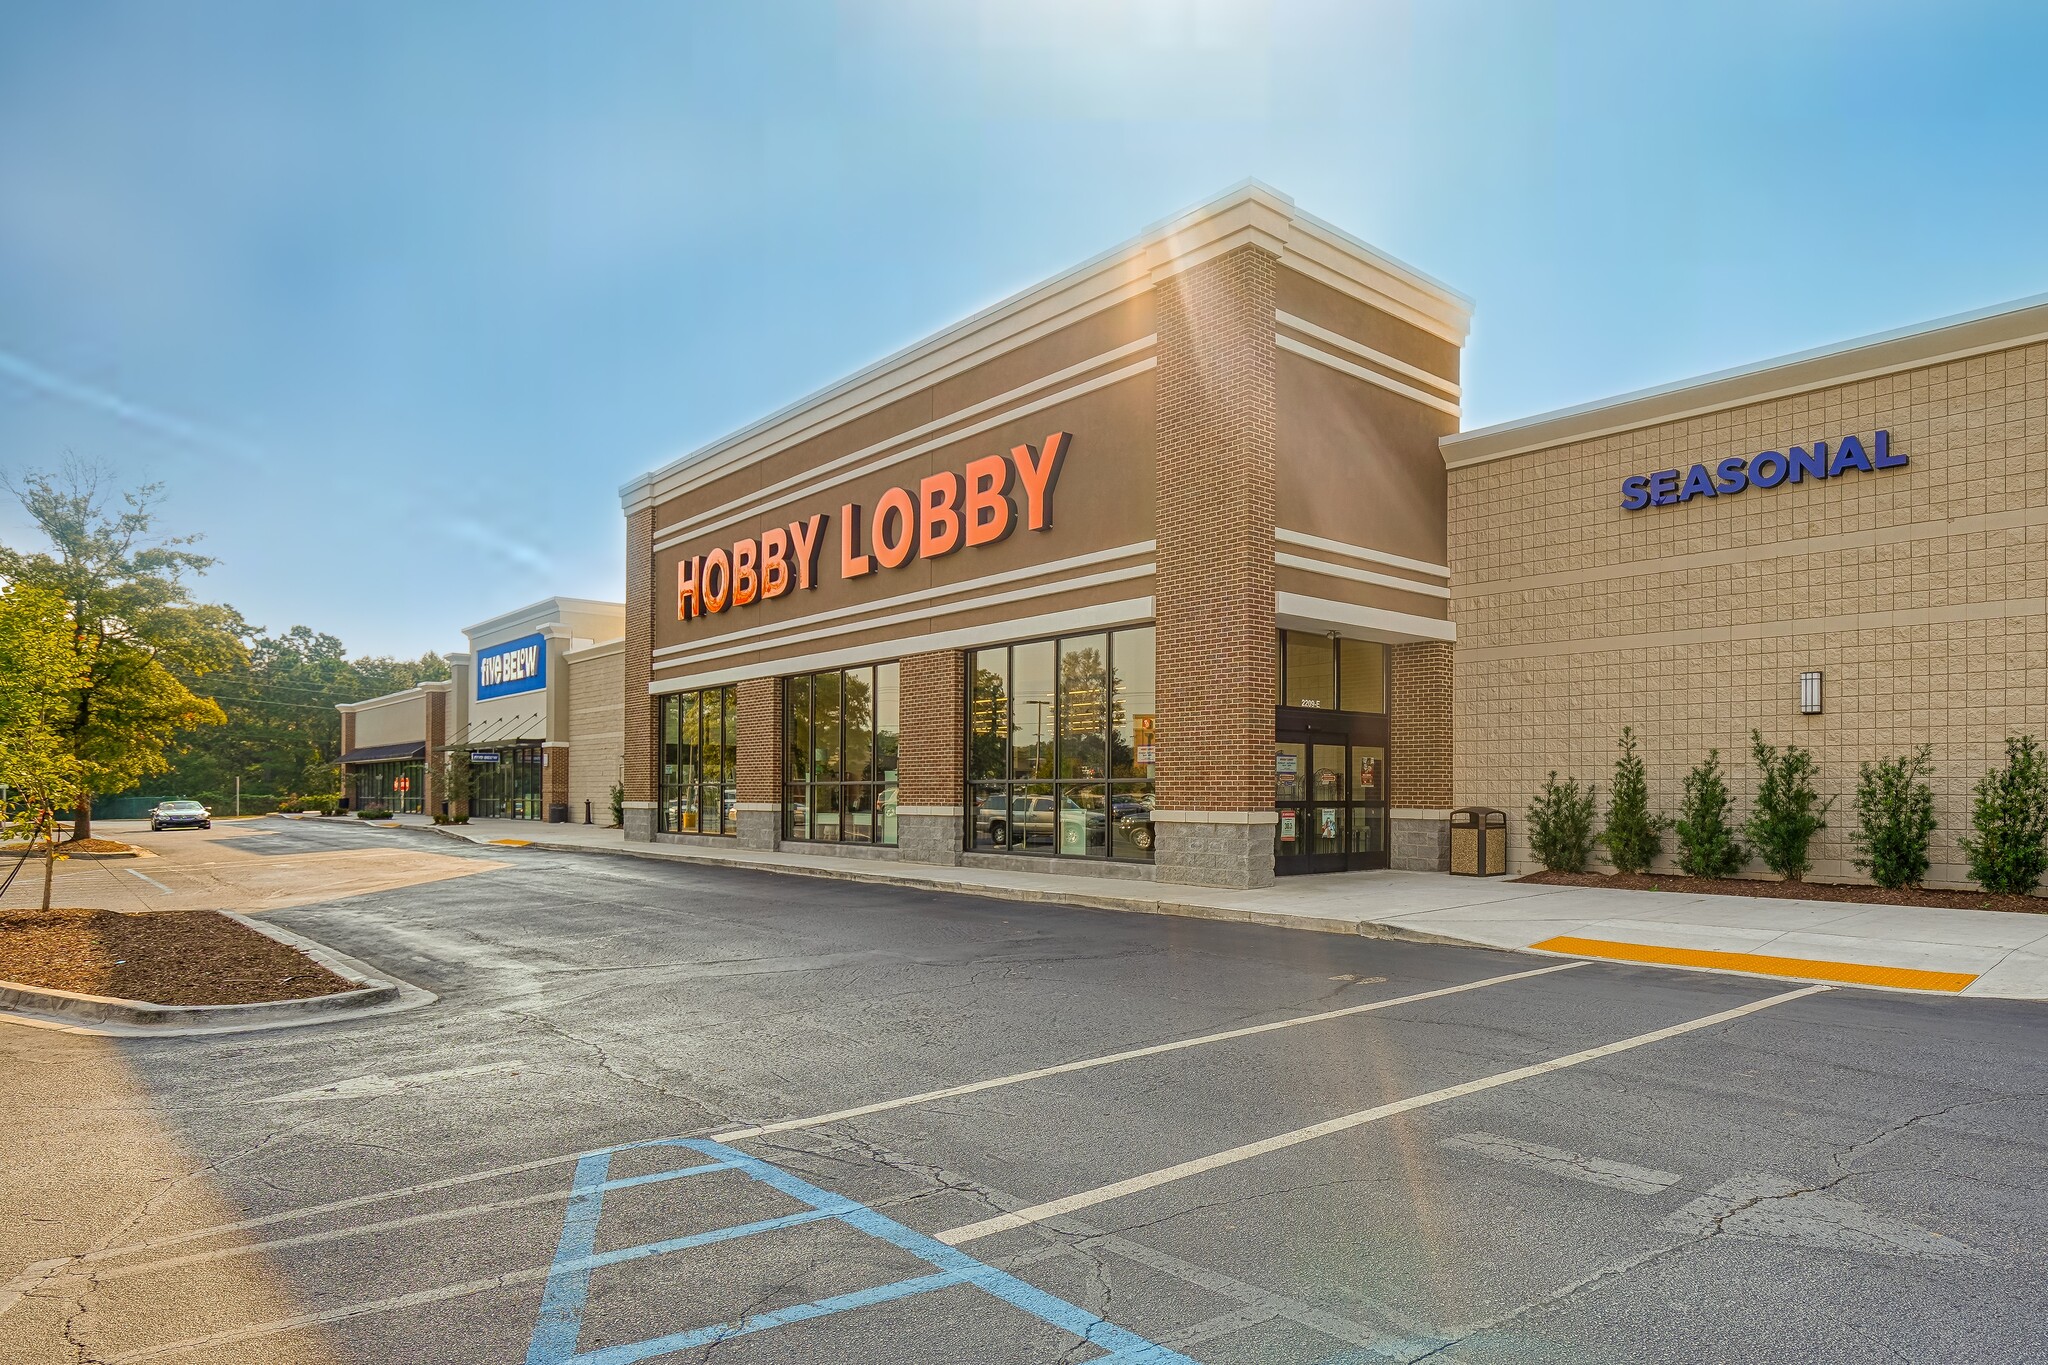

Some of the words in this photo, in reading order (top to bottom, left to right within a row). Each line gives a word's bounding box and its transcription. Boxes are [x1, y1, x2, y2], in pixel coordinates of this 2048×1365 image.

[1620, 430, 1909, 511] SEASONAL
[678, 513, 828, 621] HOBBY
[841, 431, 1071, 580] LOBBY
[481, 655, 502, 687] five
[1301, 699, 1321, 709] 2209-E
